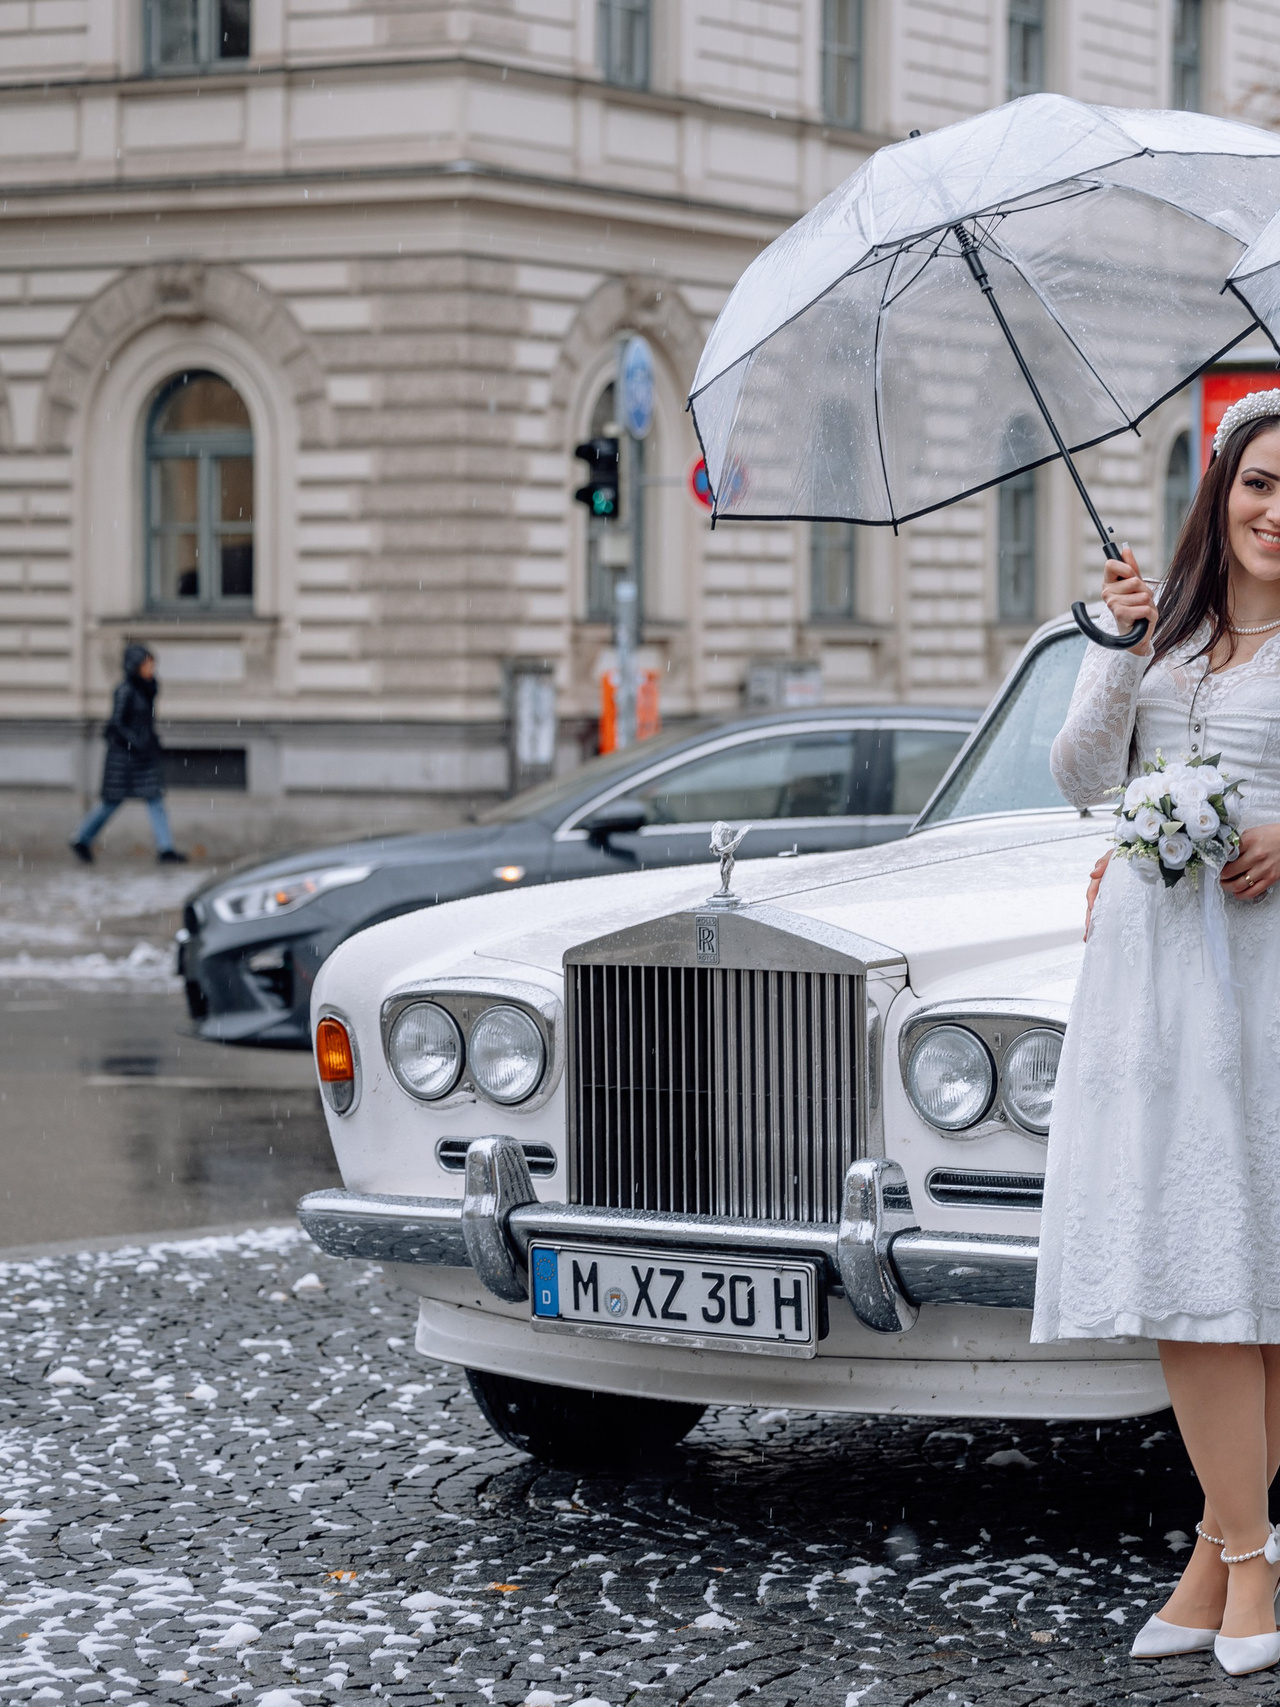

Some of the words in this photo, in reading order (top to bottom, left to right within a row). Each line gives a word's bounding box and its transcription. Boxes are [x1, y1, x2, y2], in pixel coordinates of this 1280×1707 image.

[542, 1290, 551, 1304] D
[572, 1259, 599, 1313] M
[631, 1265, 687, 1321] XZ
[701, 1271, 756, 1326] 30
[773, 1277, 803, 1332] H
